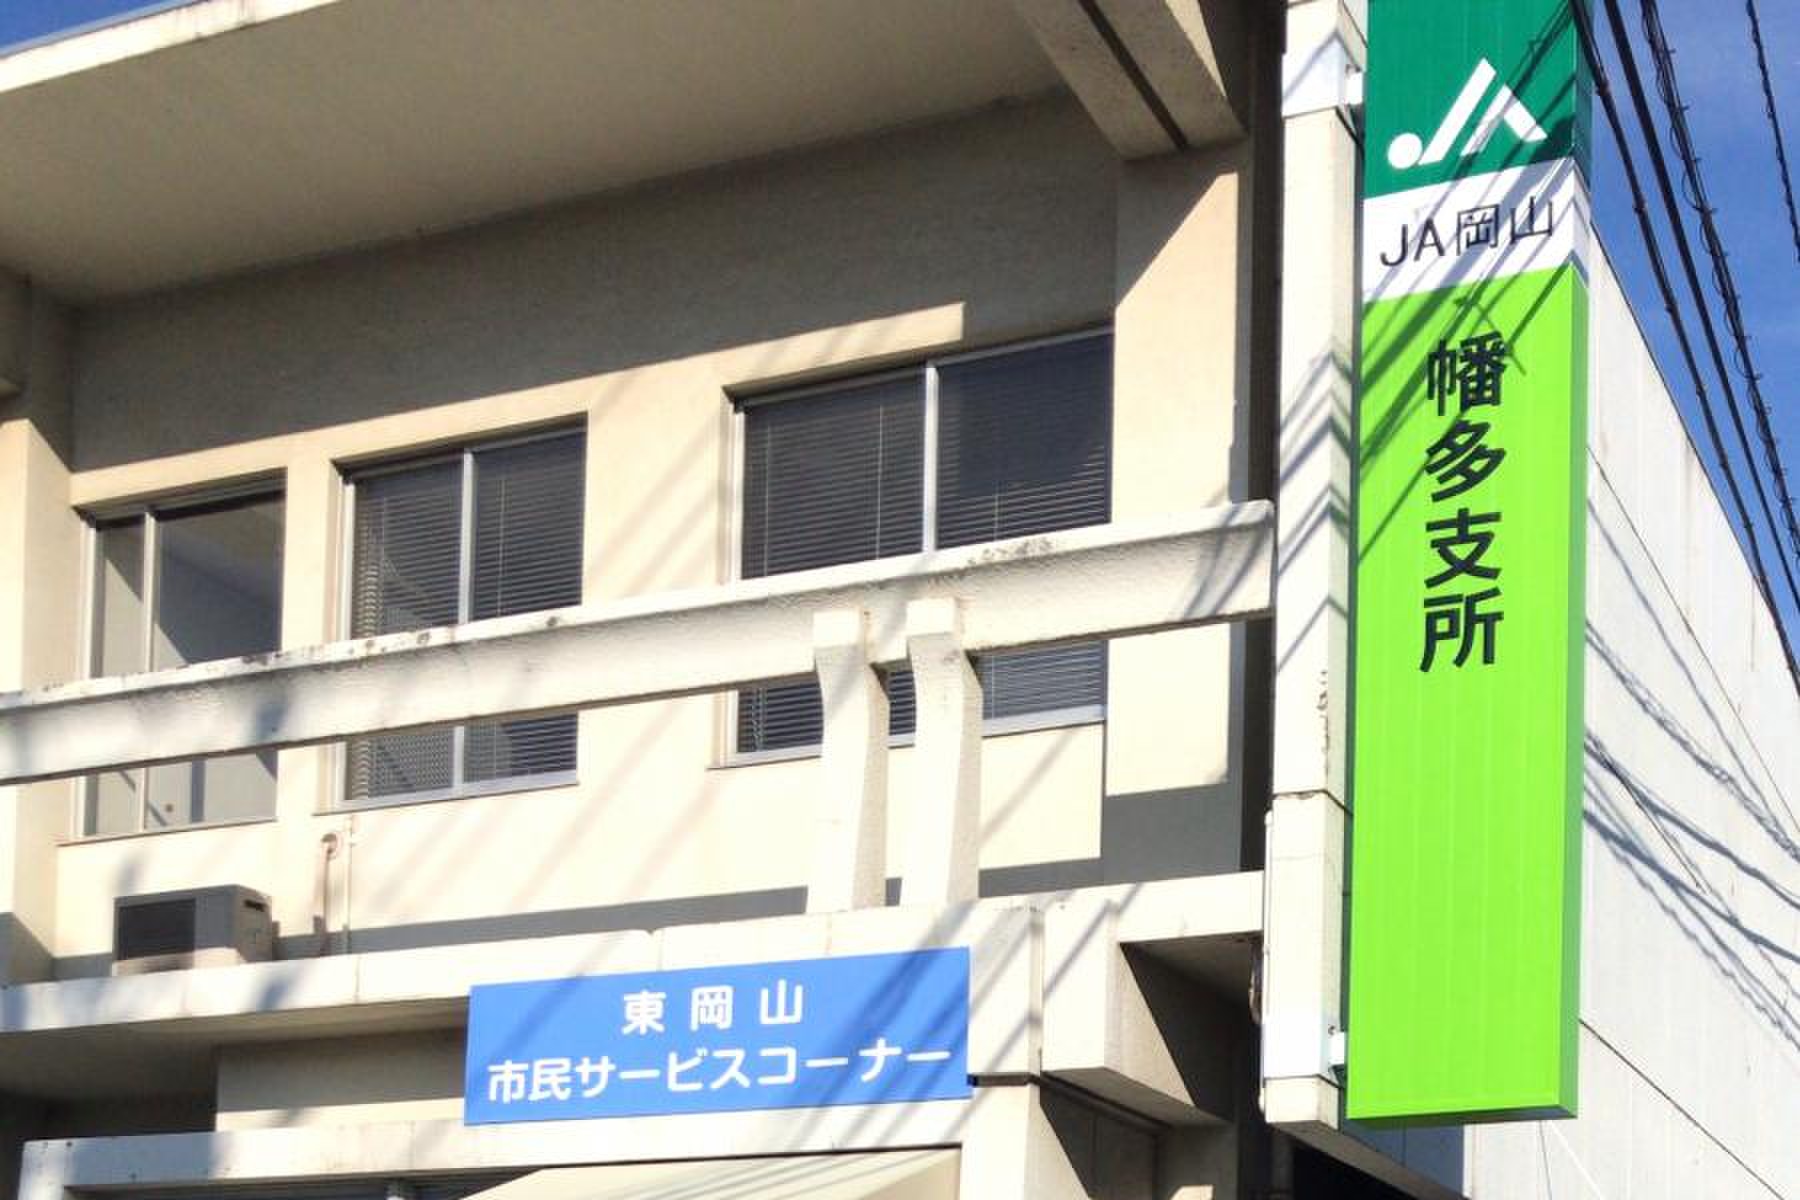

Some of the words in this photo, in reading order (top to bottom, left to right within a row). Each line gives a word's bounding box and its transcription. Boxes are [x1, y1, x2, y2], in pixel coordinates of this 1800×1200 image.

[1380, 195, 1553, 267] JA岡山
[1419, 330, 1508, 672] 幡多支所
[620, 979, 803, 1035] 東岡山
[487, 1037, 952, 1104] 市民サービスコーナー
